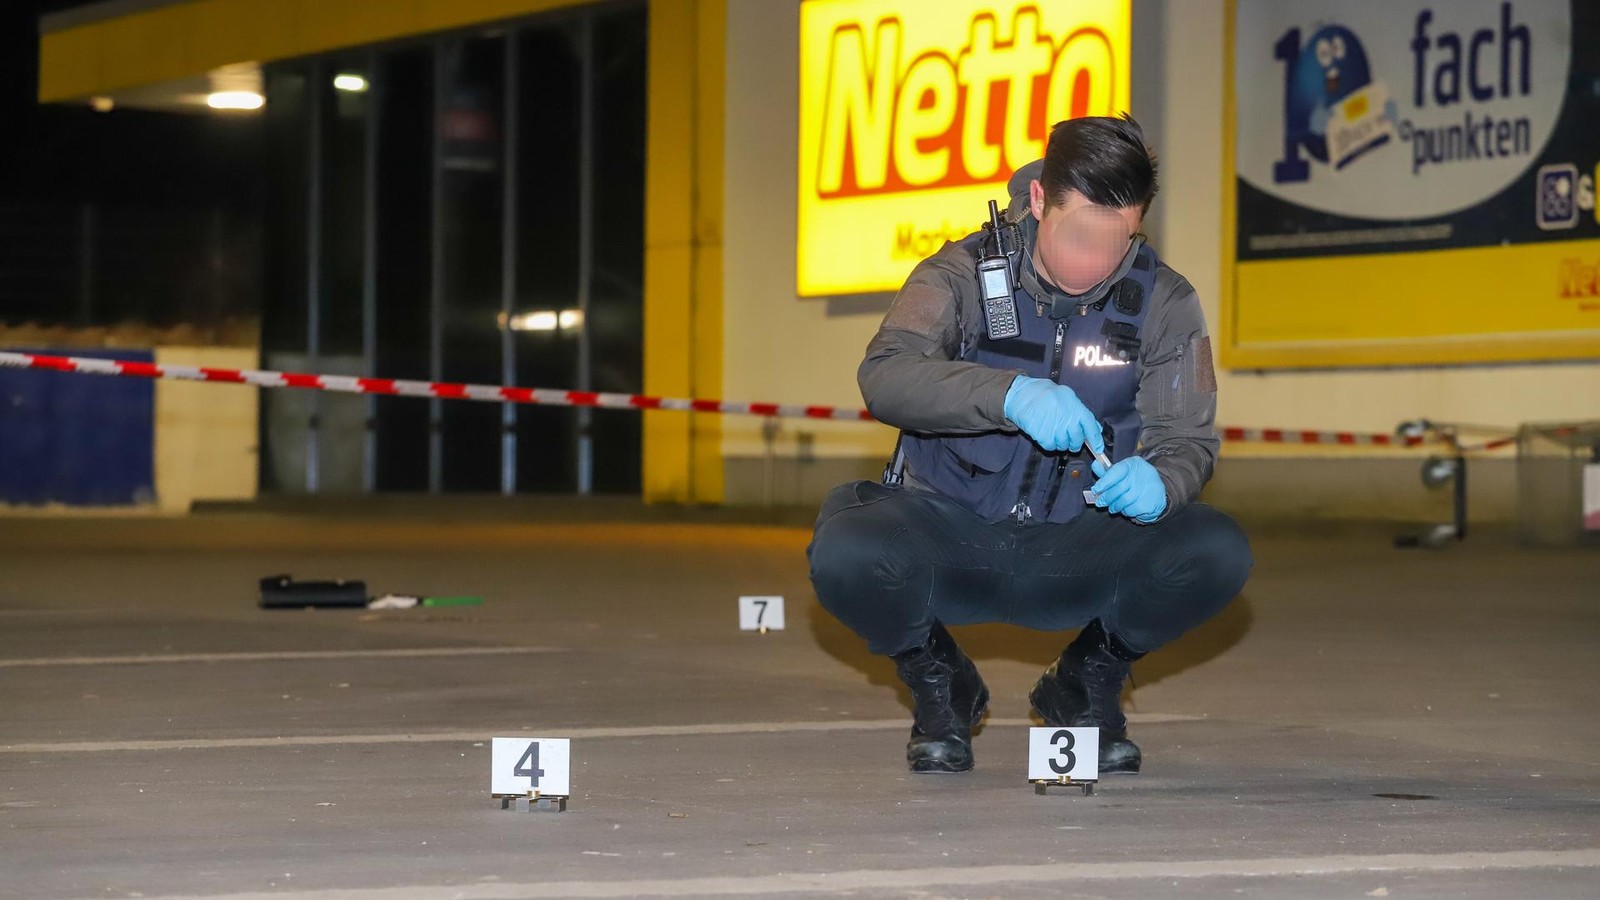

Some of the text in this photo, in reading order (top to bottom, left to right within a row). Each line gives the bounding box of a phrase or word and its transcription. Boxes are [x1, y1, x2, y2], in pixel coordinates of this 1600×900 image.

[1411, 1, 1531, 108] fach
[816, 5, 1115, 199] Netto
[753, 601, 768, 624] 7
[513, 741, 545, 788] 4
[1048, 729, 1077, 775] 3
